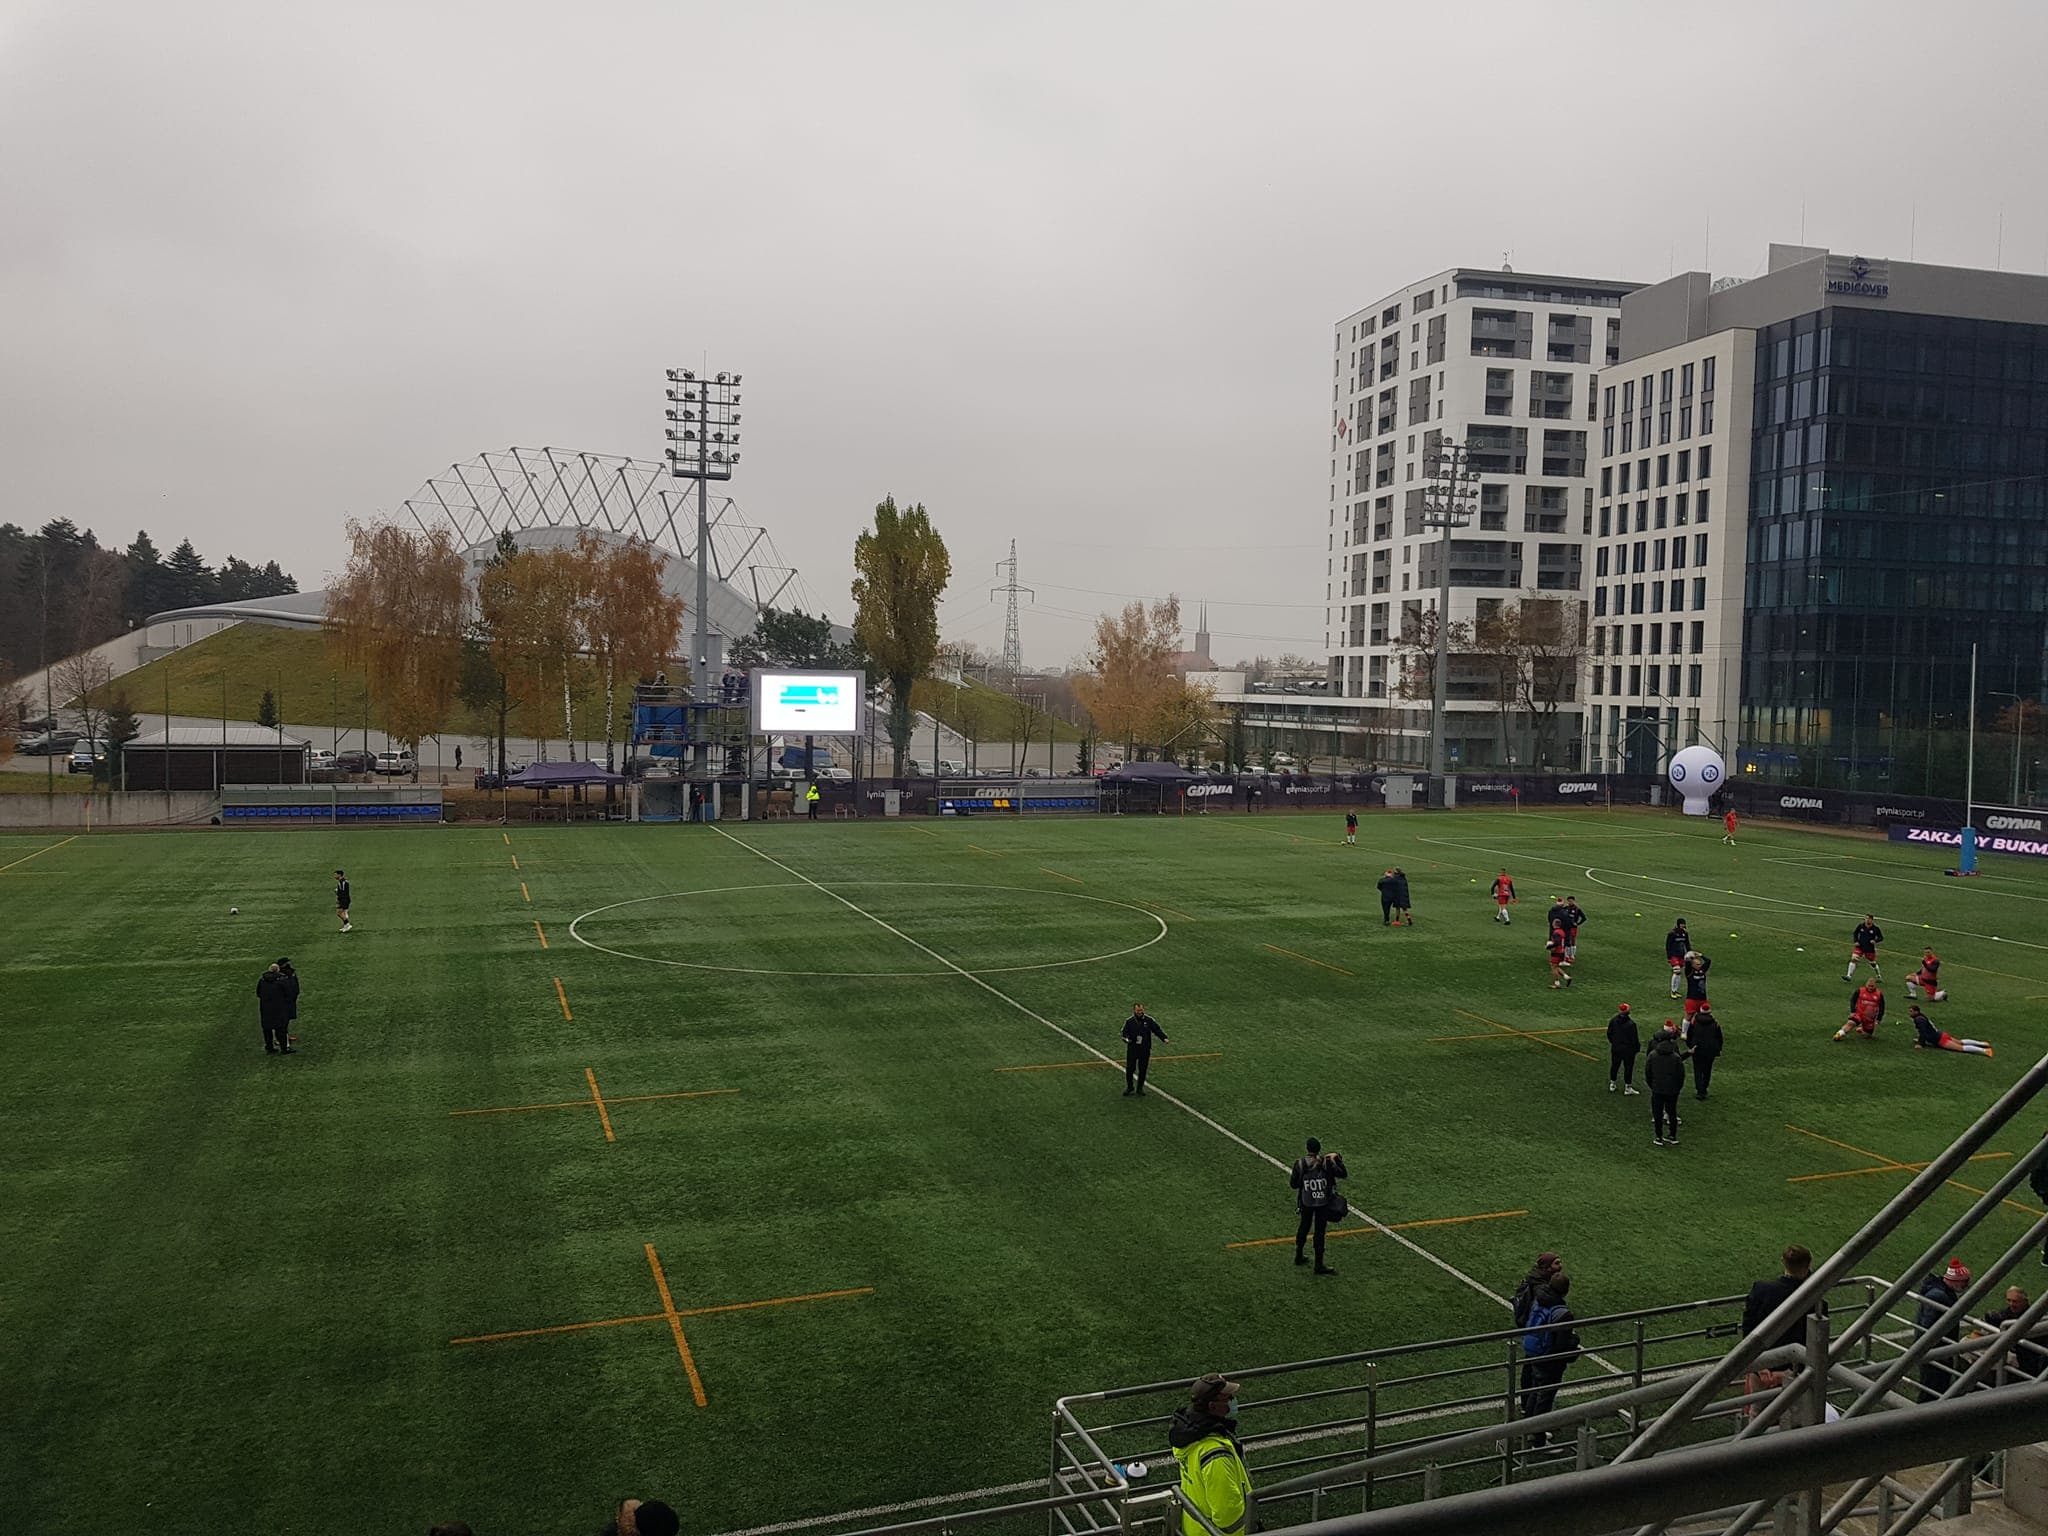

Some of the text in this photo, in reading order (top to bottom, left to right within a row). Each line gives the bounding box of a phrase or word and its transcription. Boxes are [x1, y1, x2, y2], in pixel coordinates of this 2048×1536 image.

[1828, 281, 1888, 297] MEDICOVER
[1186, 784, 1233, 797] GDYNIA
[1285, 783, 1331, 794] gdyniasport.pl
[1558, 782, 1598, 793] GDYNIA
[1780, 796, 1823, 809] GDYNIA
[1876, 806, 1925, 818] gdyniasport.pl
[1986, 815, 2042, 831] GDYNIA
[1907, 828, 2048, 856] ZAKŁAY BUKM
